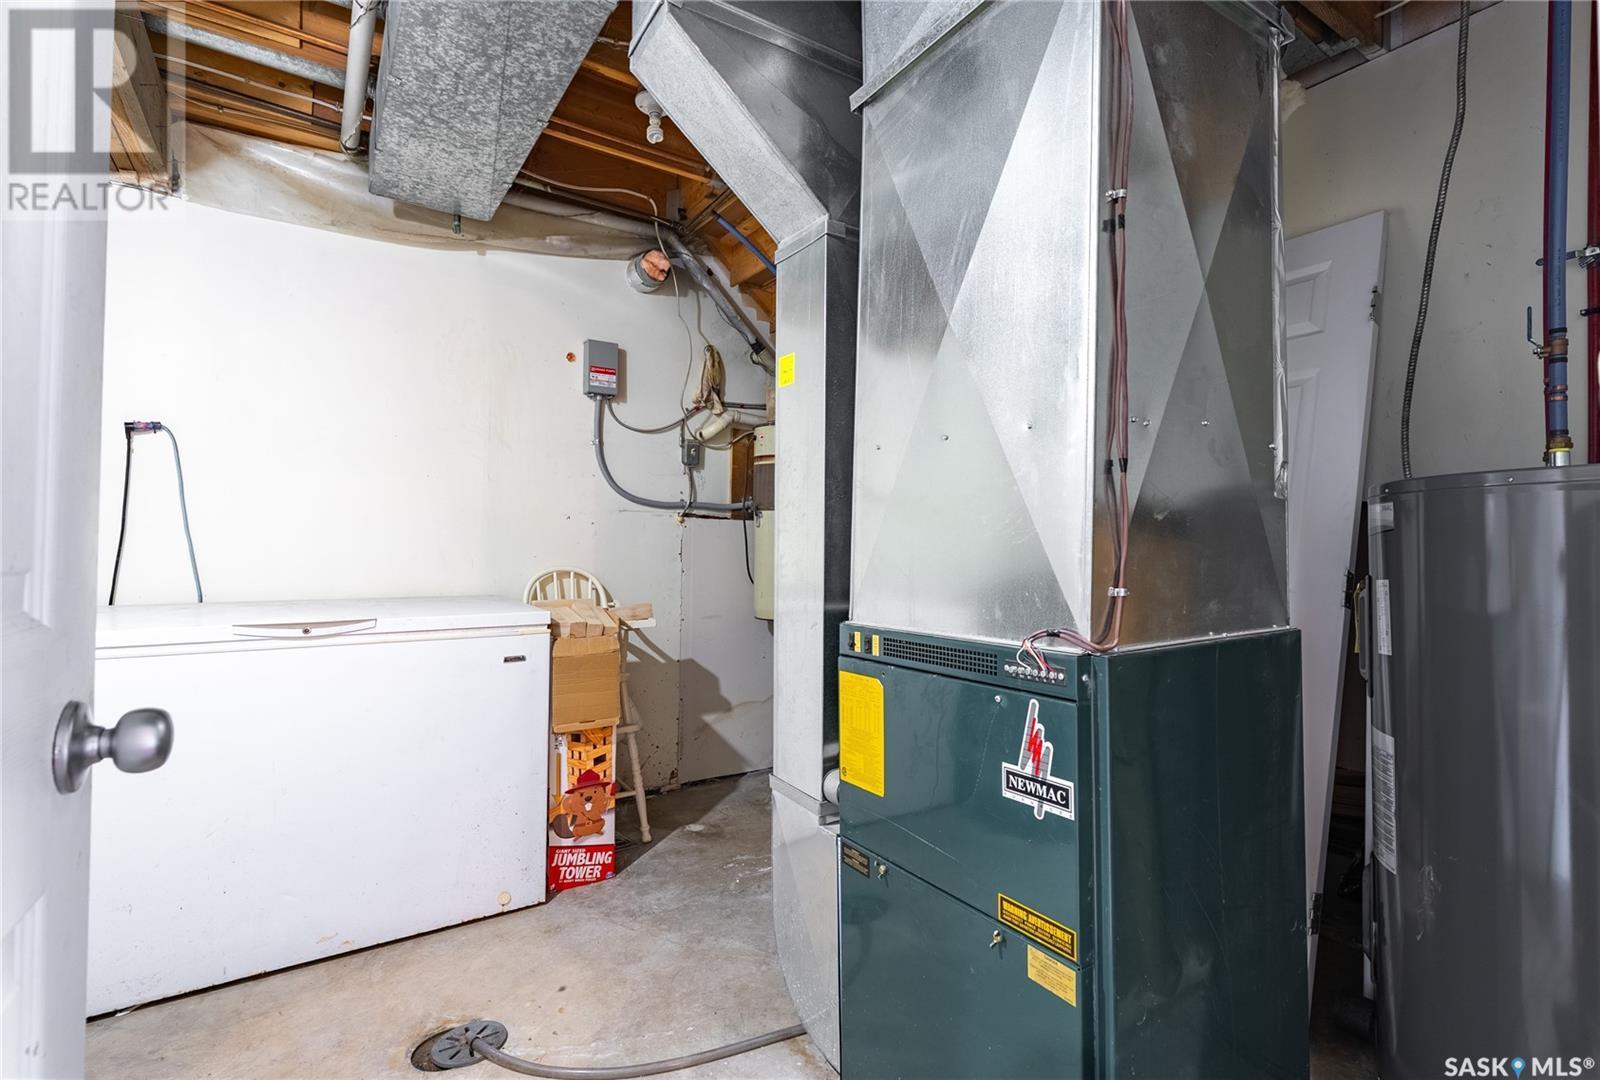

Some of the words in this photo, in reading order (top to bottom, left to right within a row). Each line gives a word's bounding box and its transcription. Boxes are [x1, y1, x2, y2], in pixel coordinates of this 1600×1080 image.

[1008, 775, 1066, 804] NEWMAC
[552, 851, 613, 867] JUMBLING
[559, 866, 602, 879] TOWER
